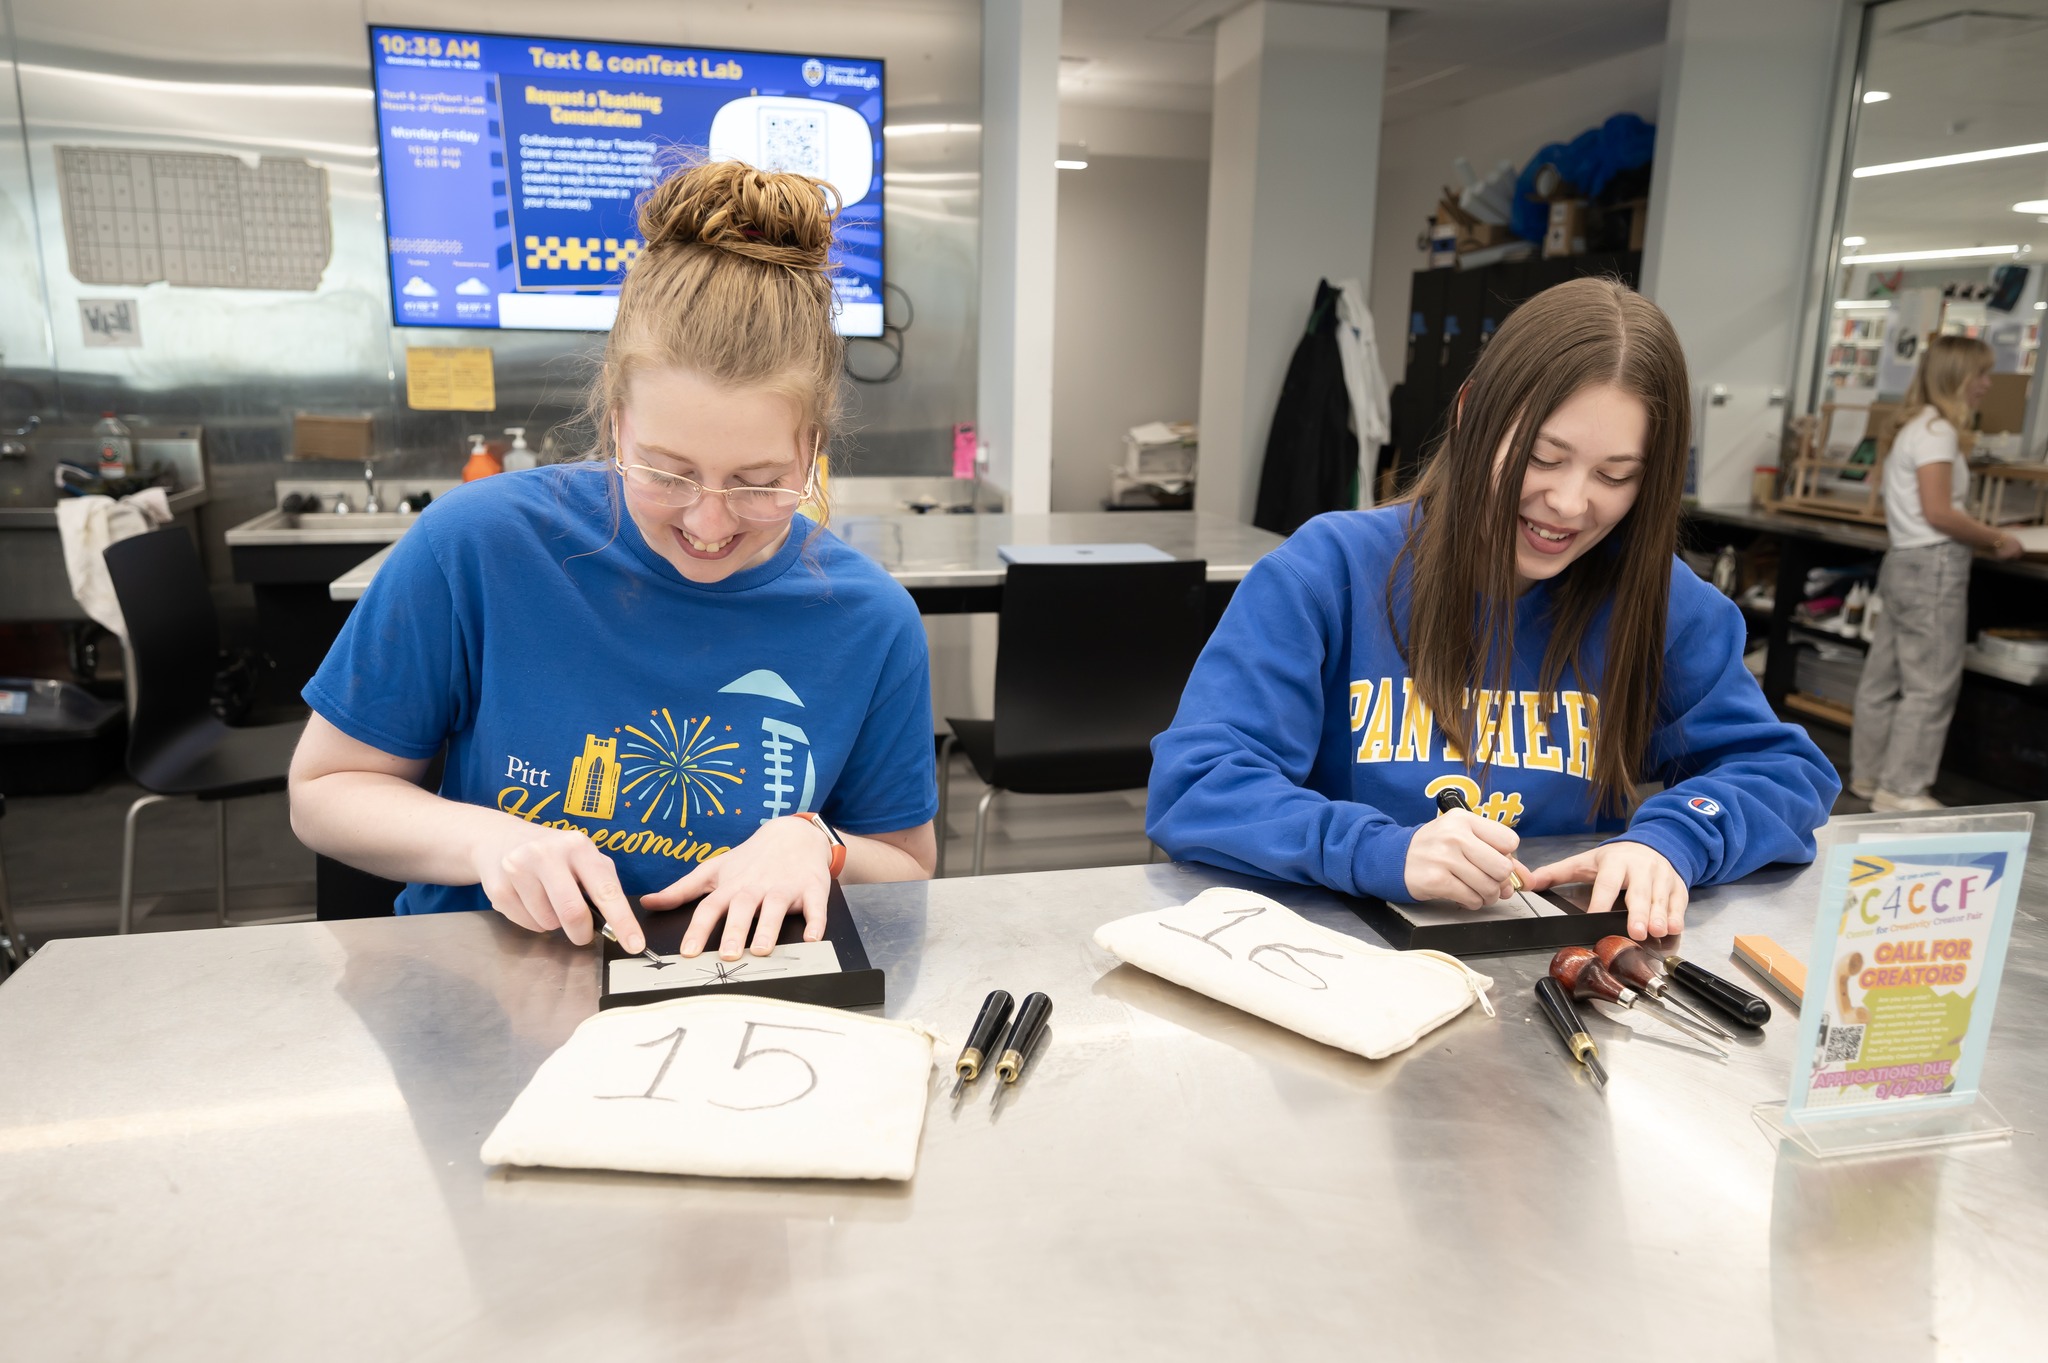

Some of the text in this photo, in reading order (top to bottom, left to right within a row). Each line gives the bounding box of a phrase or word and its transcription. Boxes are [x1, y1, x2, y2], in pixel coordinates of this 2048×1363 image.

[378, 35, 480, 59] 10:35 AM
[529, 47, 743, 80] Text & conText Lab
[525, 86, 663, 114] Request a Teaching
[550, 106, 642, 128] Consultation
[1350, 677, 1600, 781] PANHER
[504, 755, 551, 788] Pitt
[1425, 774, 1525, 828] Ptt
[1876, 926, 1888, 935] for
[1890, 919, 1930, 932] Creativity
[1933, 915, 1965, 925] Creator
[1966, 912, 1983, 920] Fair
[1158, 907, 1344, 990] 16
[1875, 939, 1972, 964] CALL FOR
[1859, 963, 1967, 989] CREATORS
[594, 1021, 846, 1111] 15
[1813, 1060, 1952, 1089] APPLICATIONS DUE
[1876, 1078, 1945, 1099] 3/6/2026
